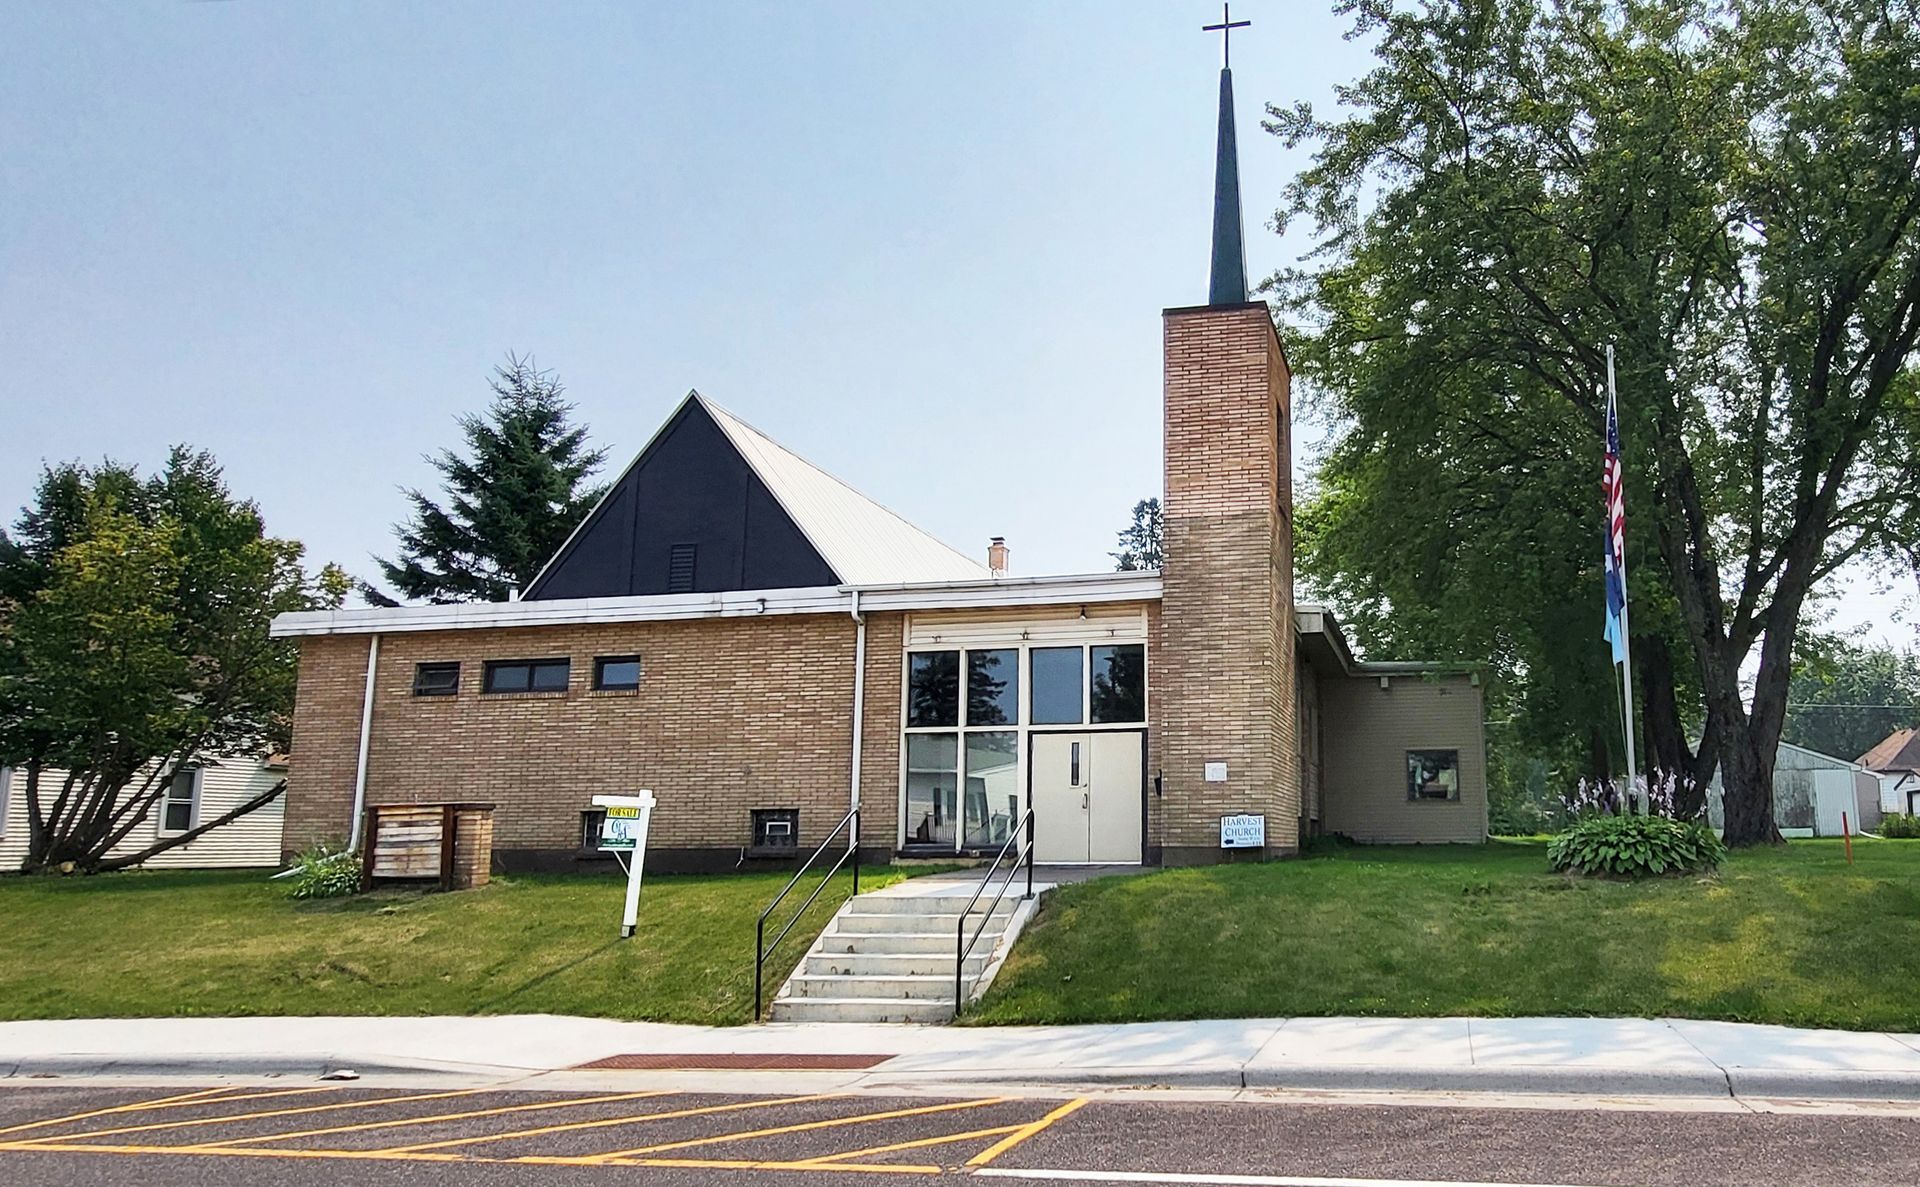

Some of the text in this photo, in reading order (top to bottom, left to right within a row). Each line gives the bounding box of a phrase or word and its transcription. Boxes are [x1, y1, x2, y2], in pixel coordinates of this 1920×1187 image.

[608, 807, 637, 817] FOR SALE
[1223, 817, 1263, 826] HARVEST
[1224, 827, 1261, 837] CHURCH
